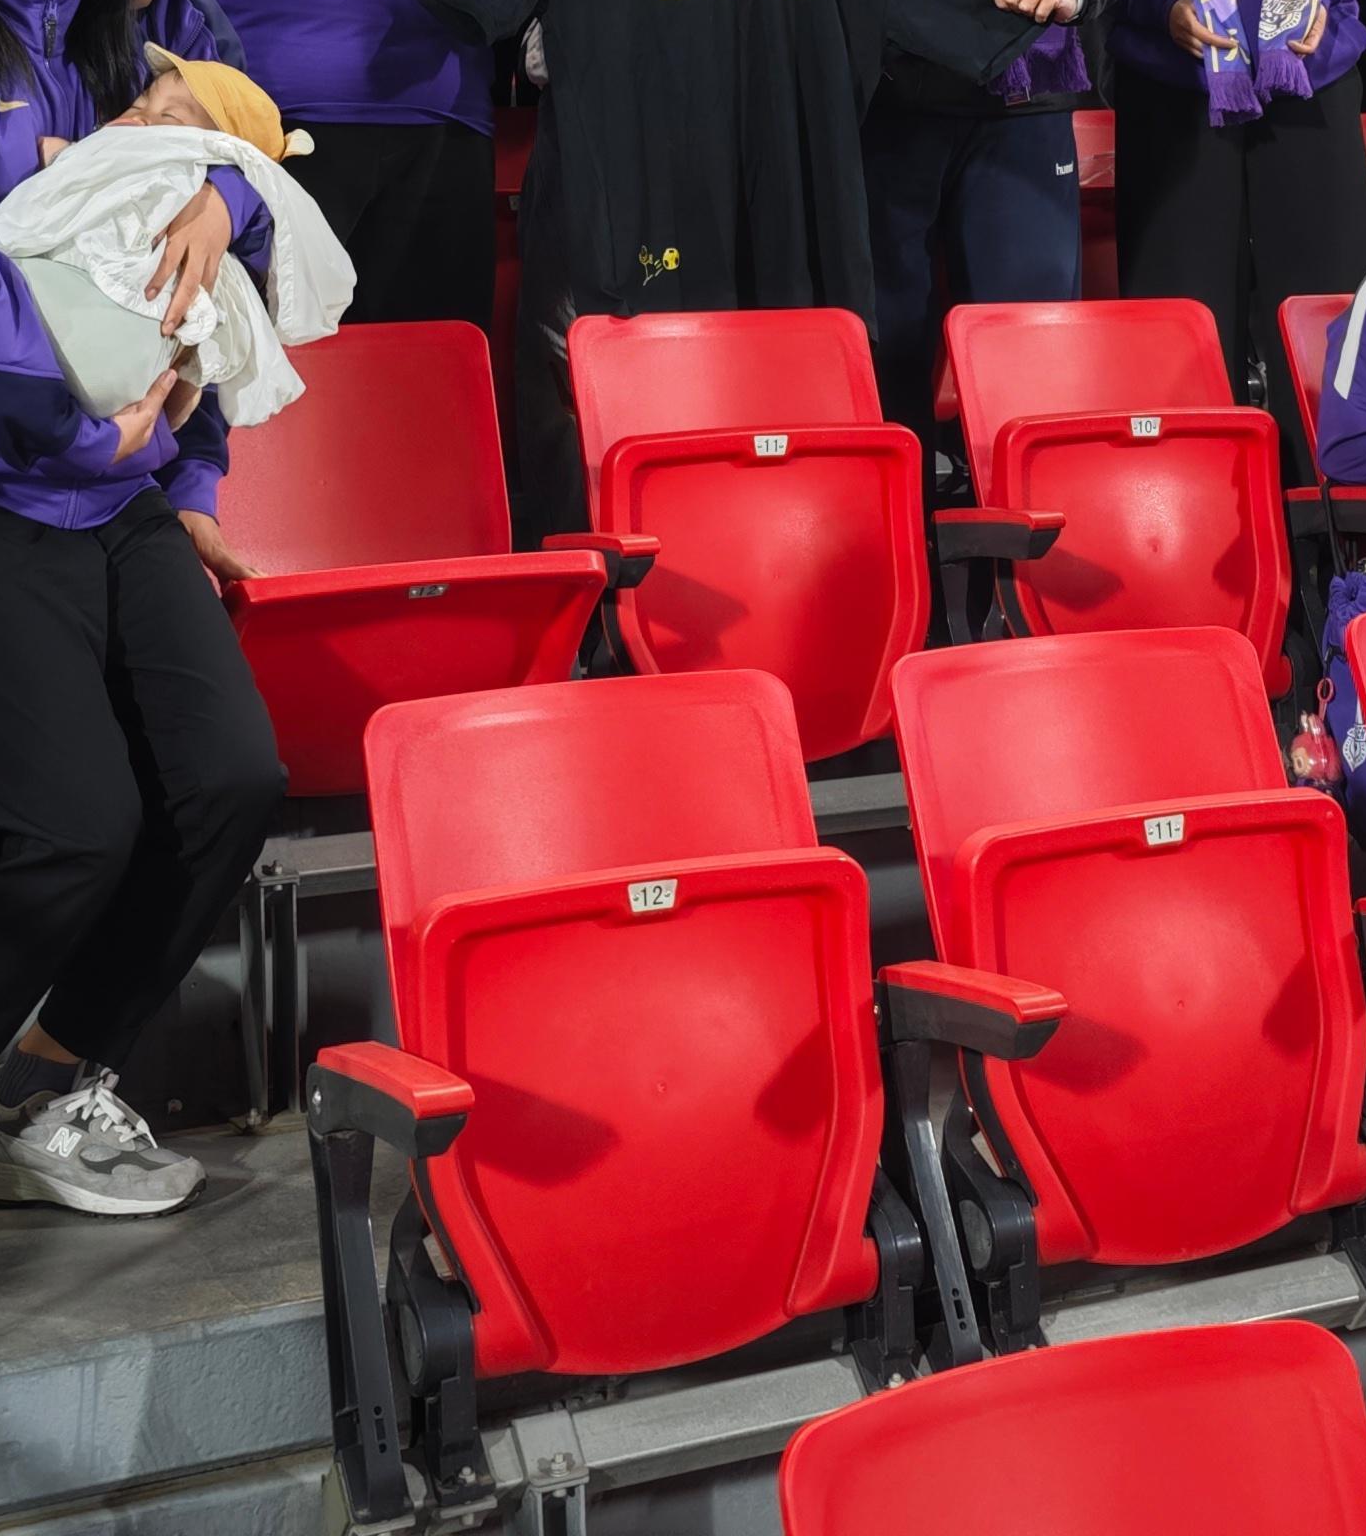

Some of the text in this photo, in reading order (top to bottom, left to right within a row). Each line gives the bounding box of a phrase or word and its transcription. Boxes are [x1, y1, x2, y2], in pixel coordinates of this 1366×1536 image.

[1138, 420, 1152, 434] 10
[764, 438, 779, 453] 11
[1154, 820, 1173, 840] 11
[640, 885, 664, 907] 12
[45, 1126, 83, 1159] N
